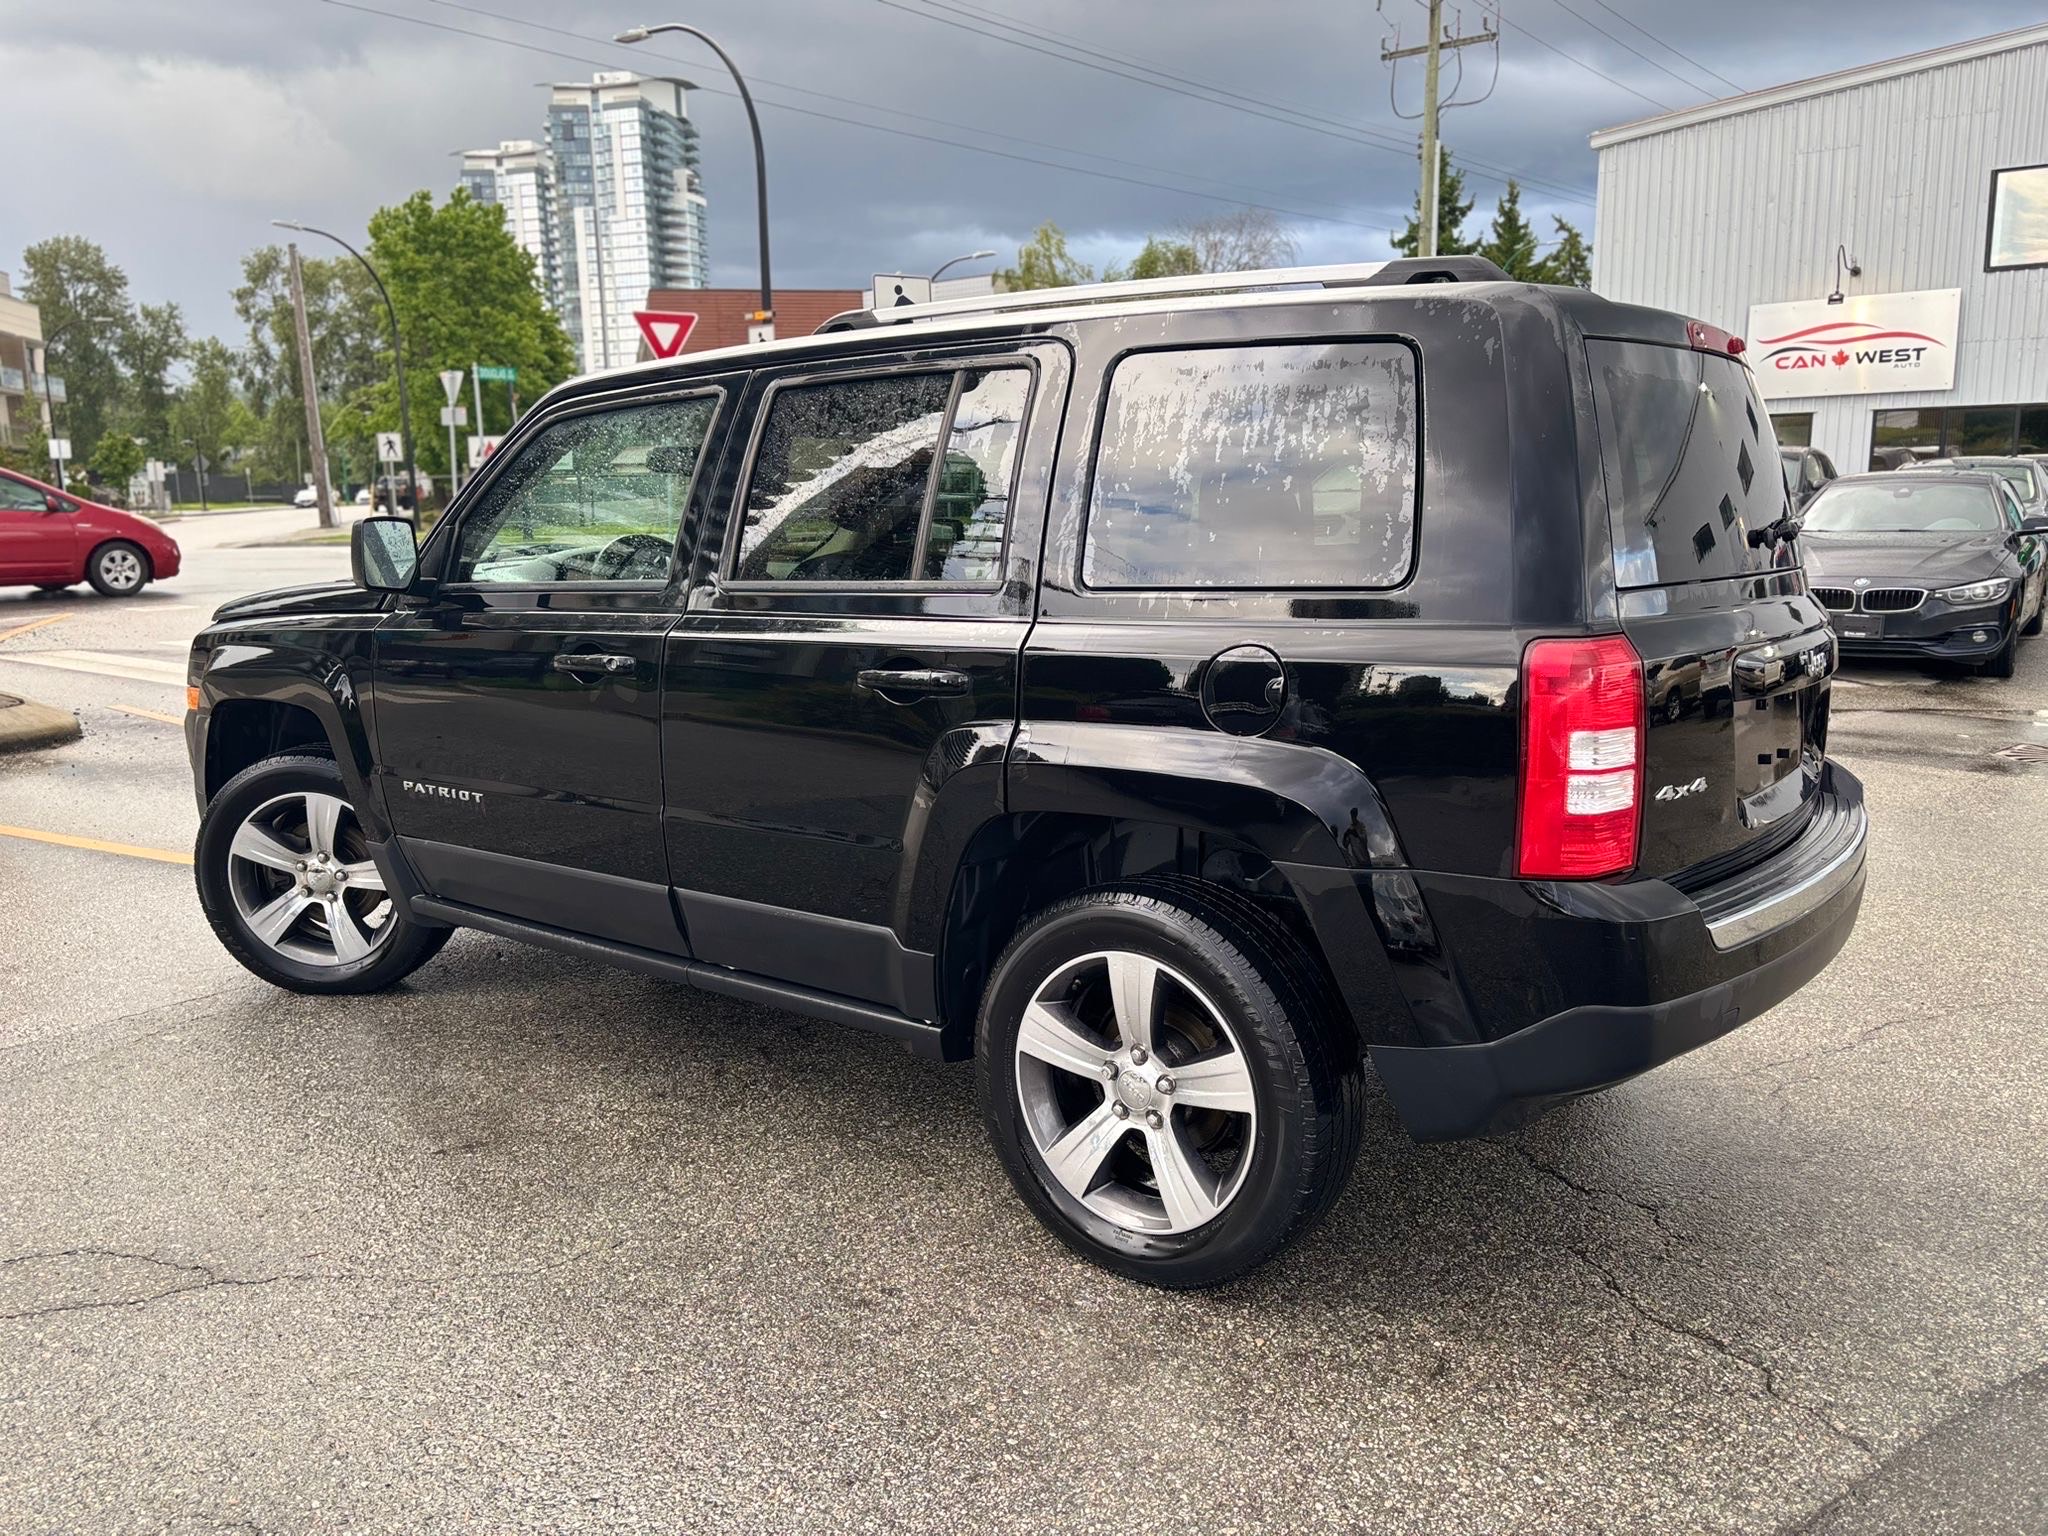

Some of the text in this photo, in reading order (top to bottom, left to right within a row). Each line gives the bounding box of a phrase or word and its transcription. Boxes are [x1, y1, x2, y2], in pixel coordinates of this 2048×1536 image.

[1775, 347, 1928, 370] CAN WEST
[403, 781, 484, 803] PATRIOT
[1654, 776, 1708, 801] 4x4
